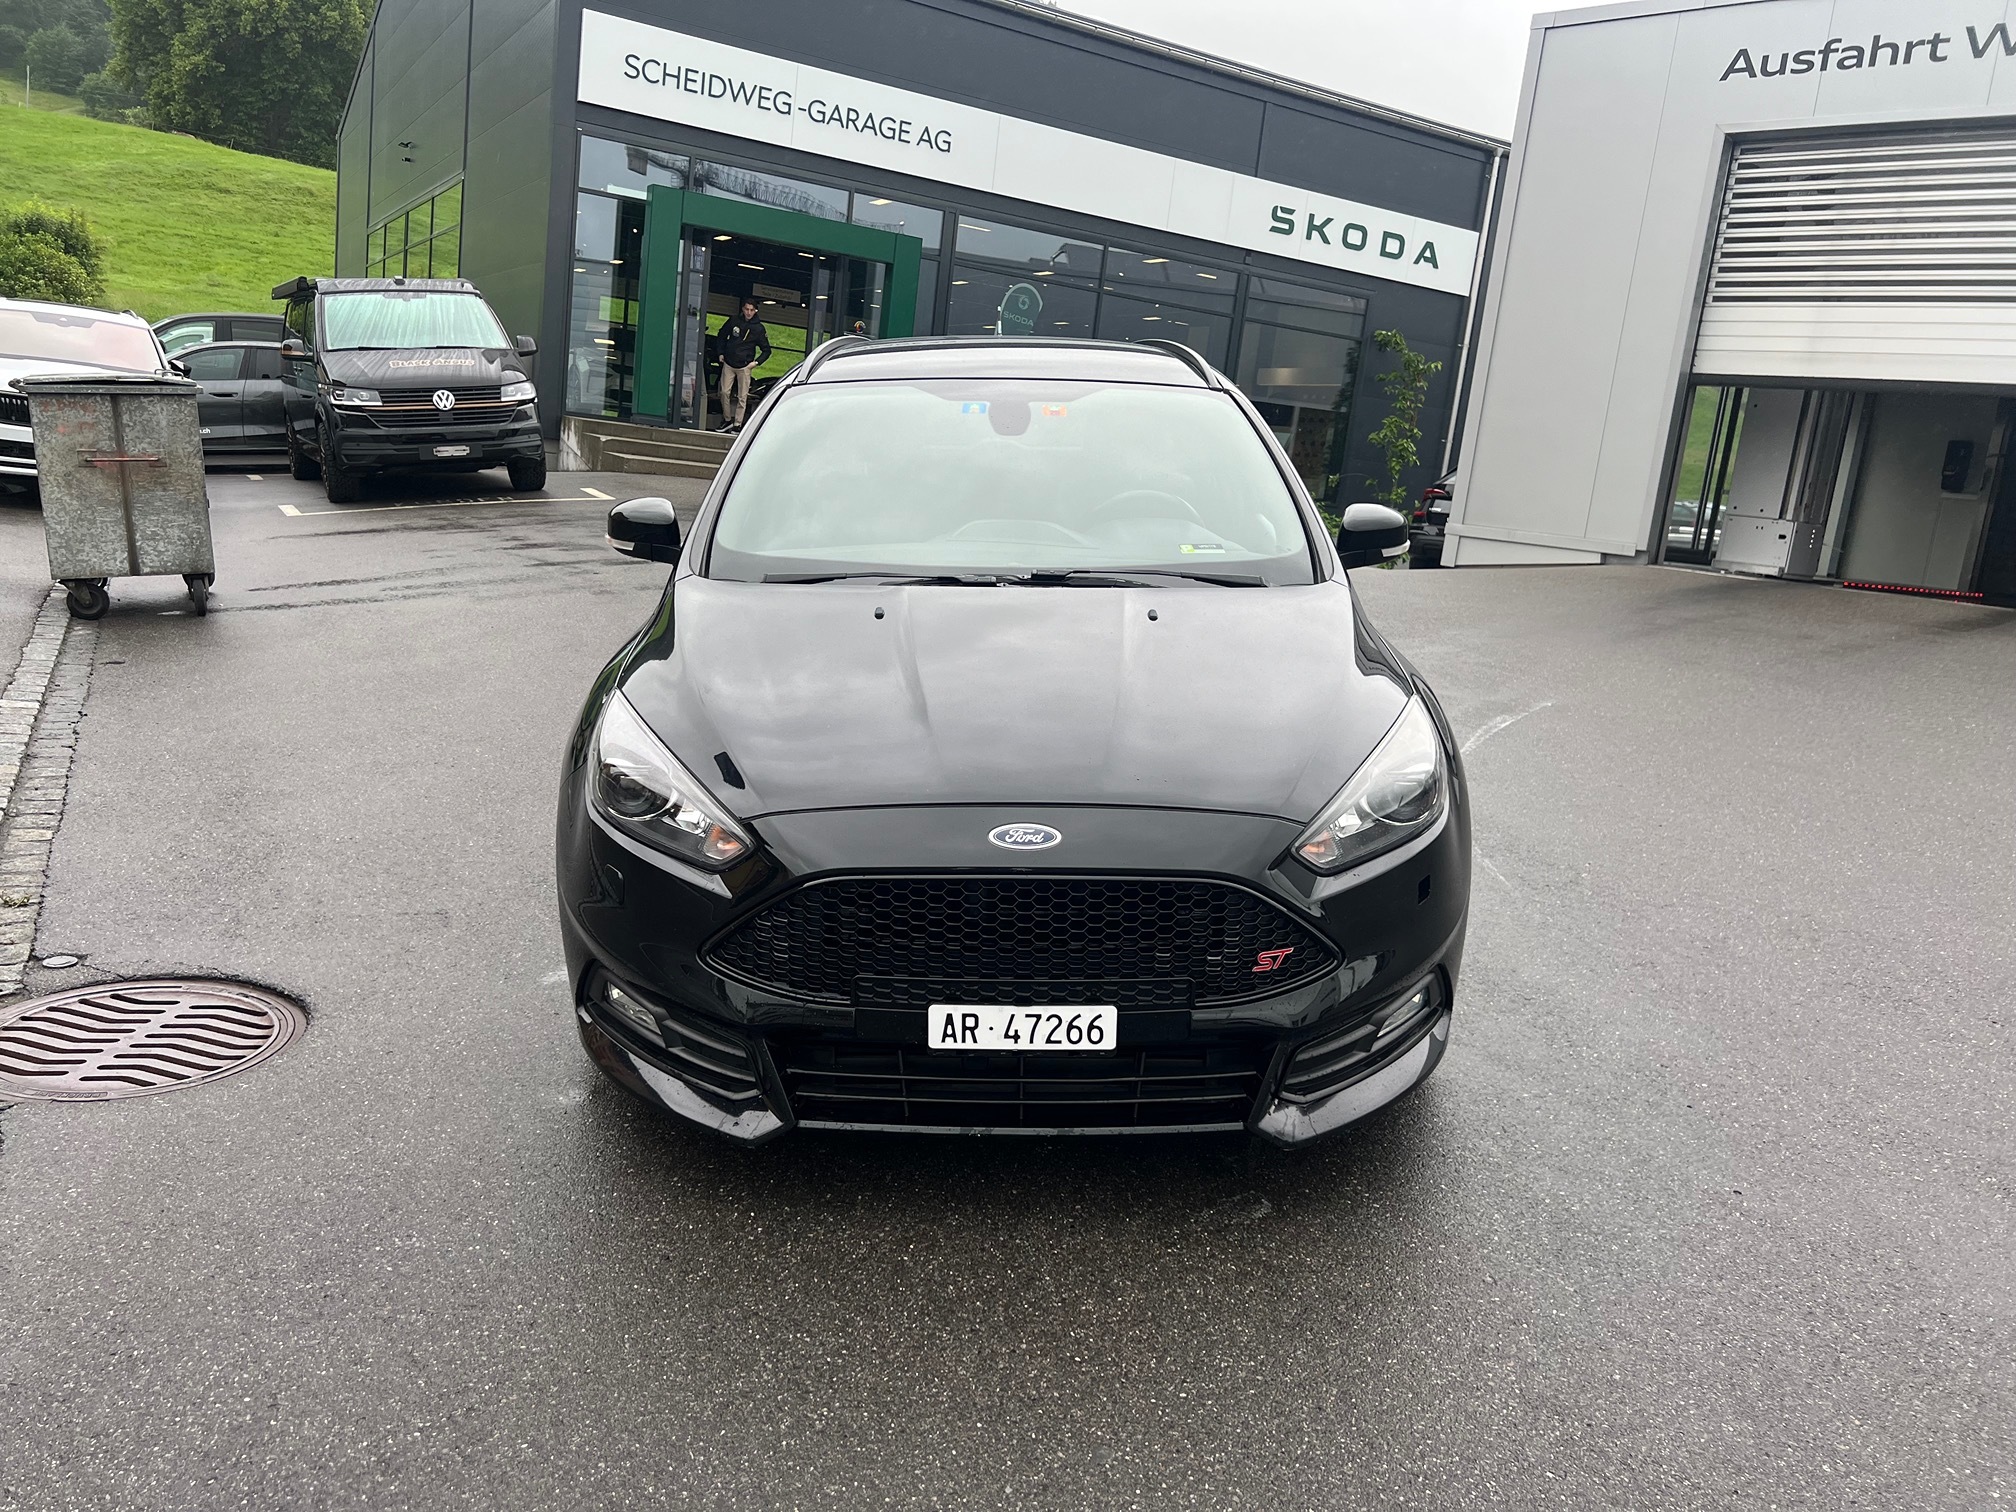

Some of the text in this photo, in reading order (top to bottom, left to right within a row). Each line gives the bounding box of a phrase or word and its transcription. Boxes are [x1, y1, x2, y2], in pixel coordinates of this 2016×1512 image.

[1718, 32, 1951, 82] Ausfahrt
[623, 54, 952, 154] SCHEIDWEG-GARAGE AG
[1251, 947, 1295, 972] ST
